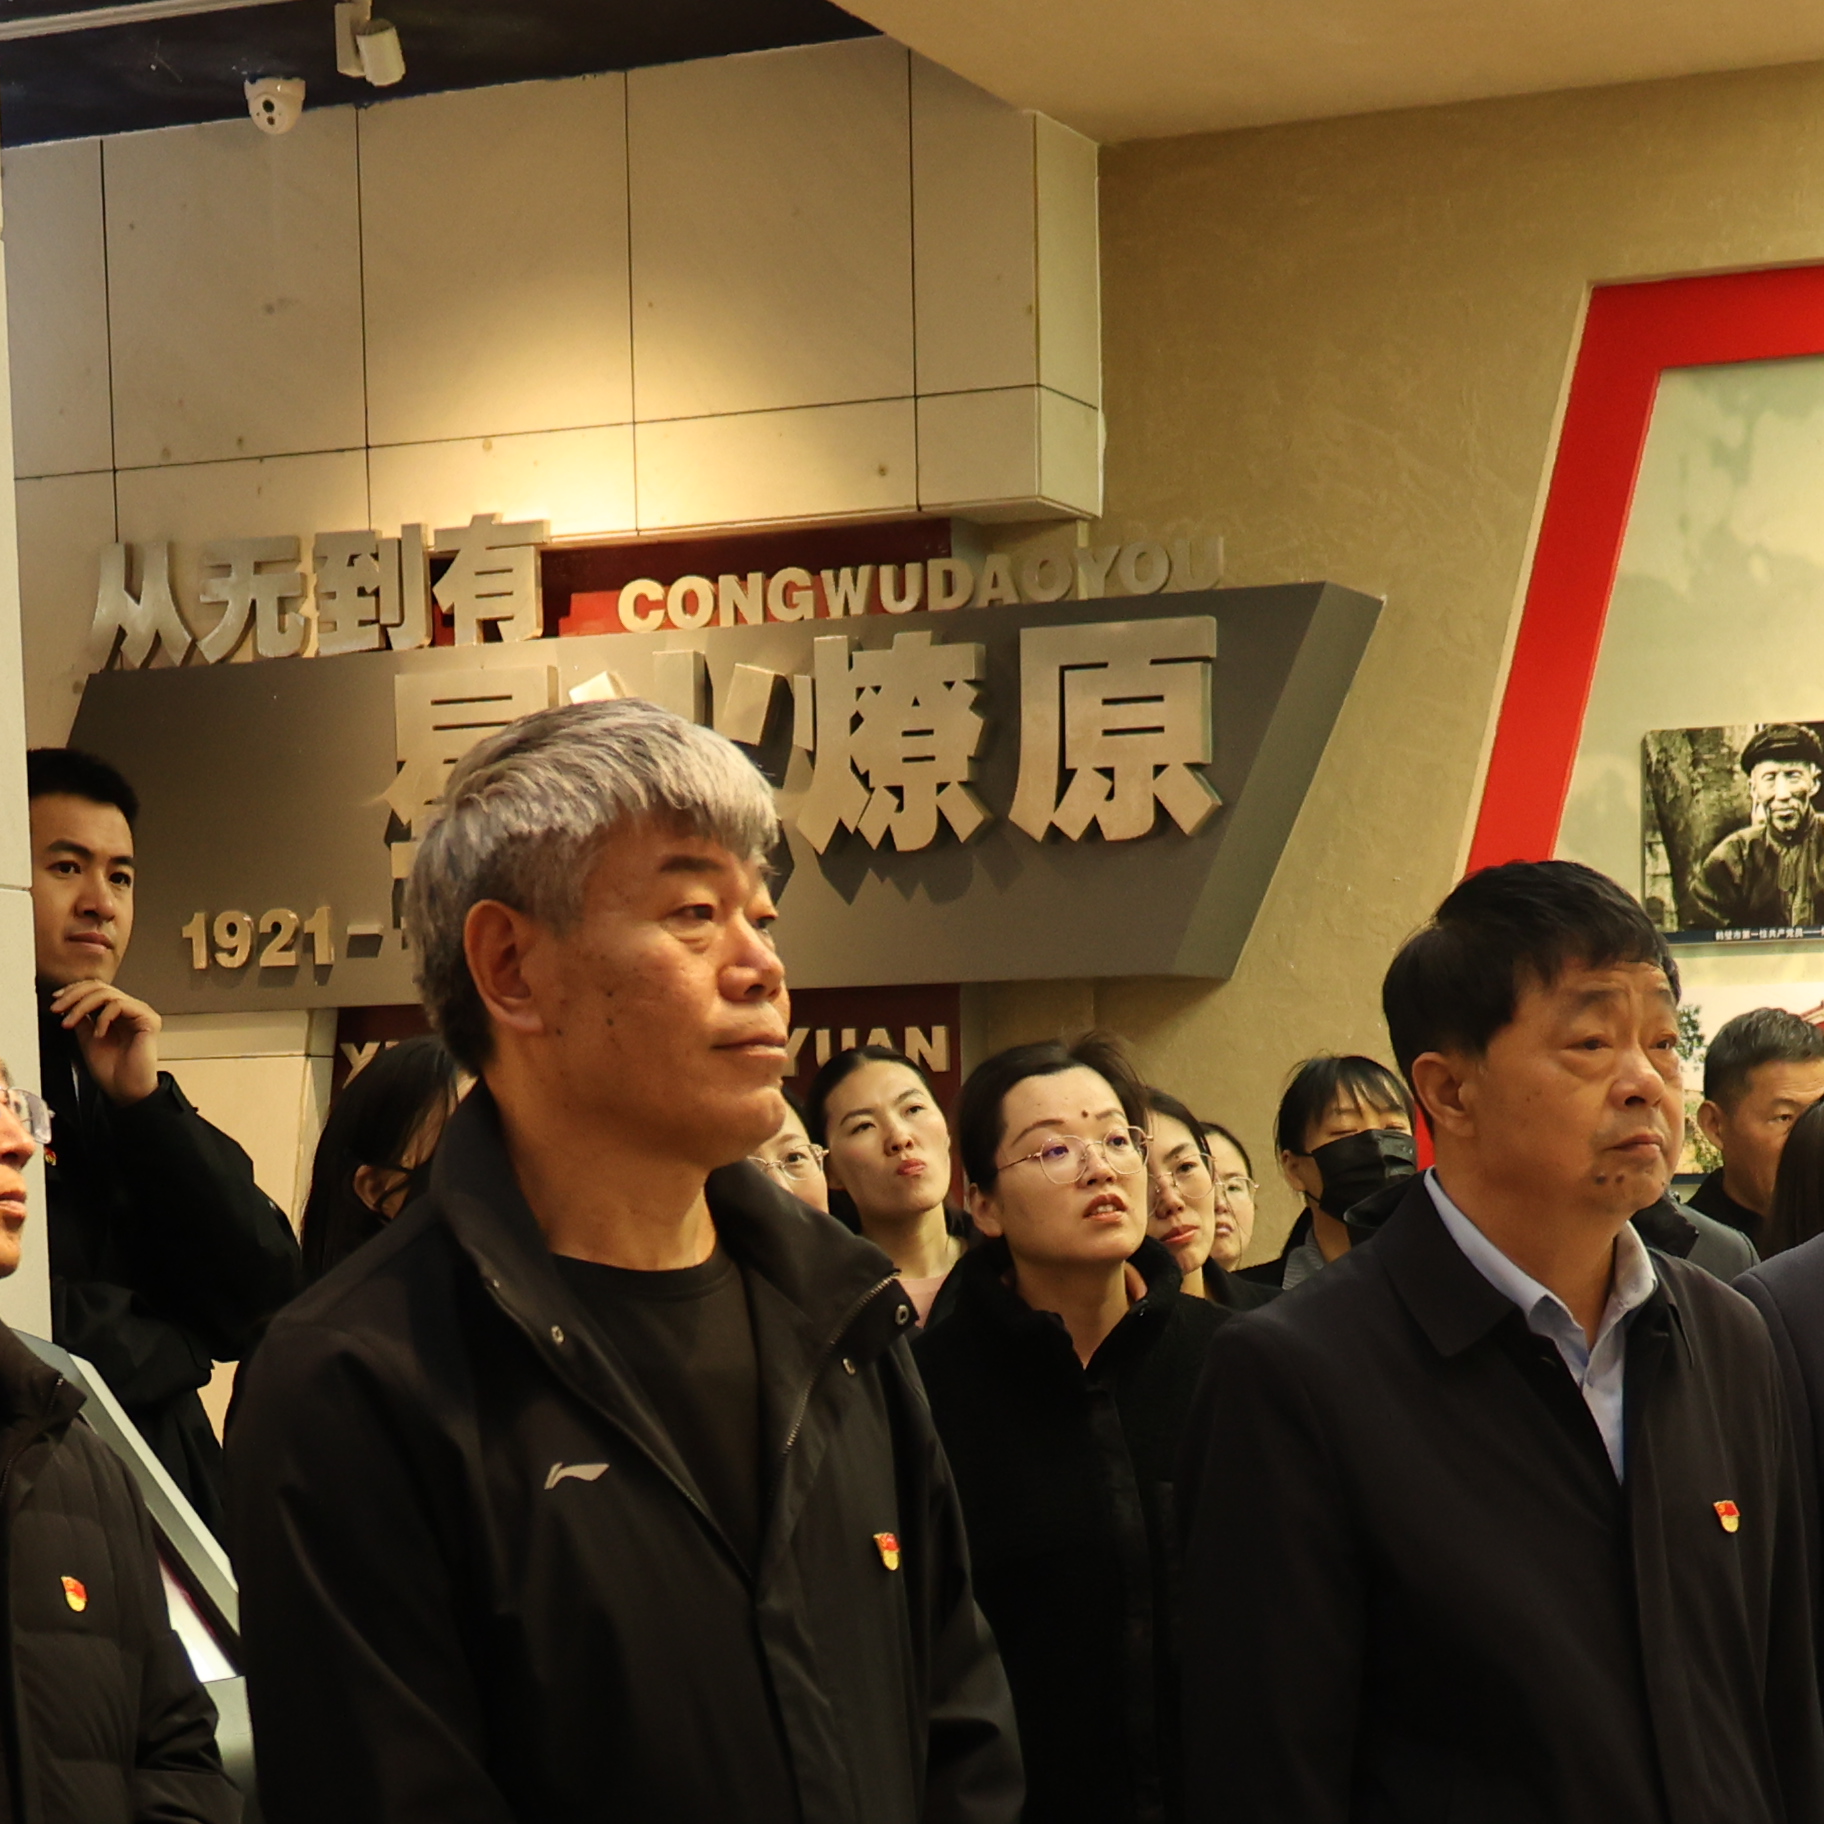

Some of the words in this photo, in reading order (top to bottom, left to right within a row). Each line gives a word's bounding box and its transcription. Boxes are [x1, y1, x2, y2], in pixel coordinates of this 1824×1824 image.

[90, 513, 545, 670] 从无到有
[617, 534, 1226, 634] CONGWUDAOYOU
